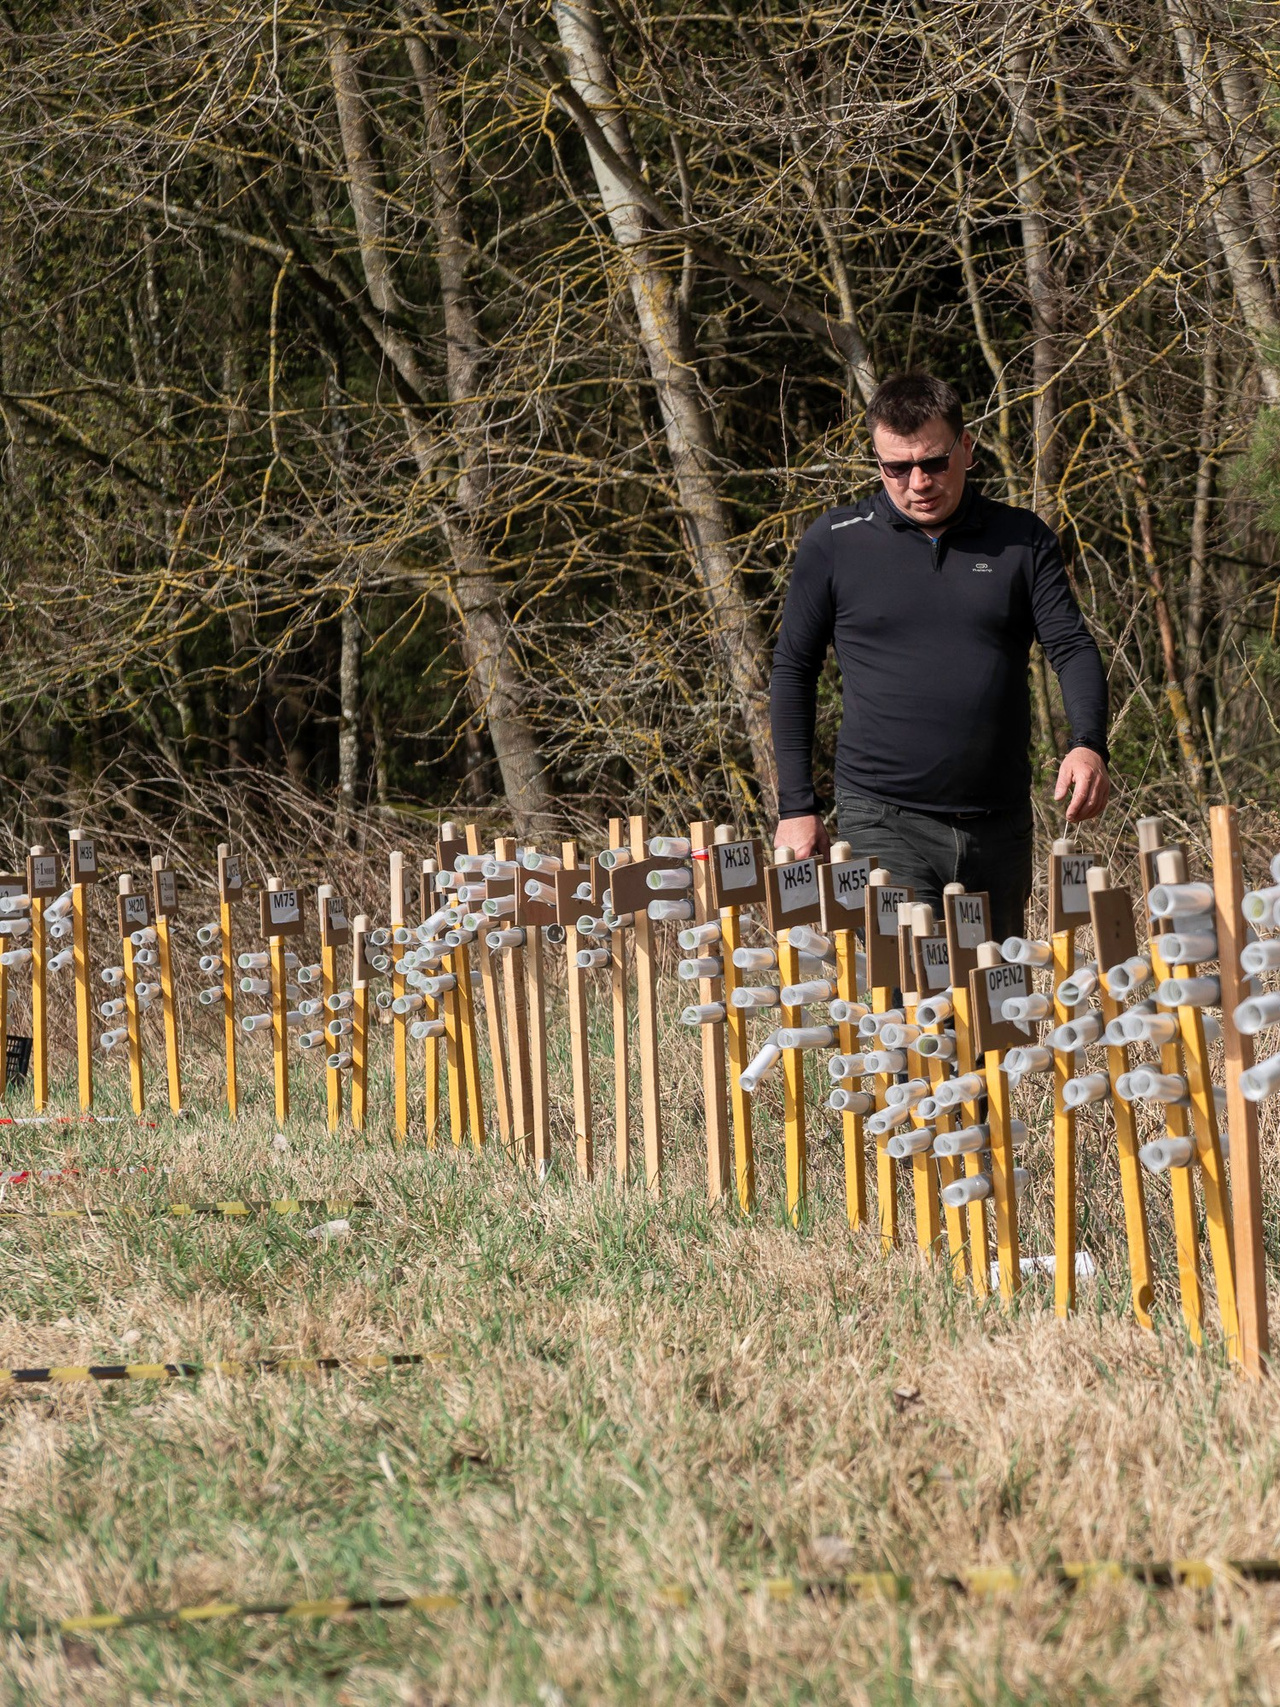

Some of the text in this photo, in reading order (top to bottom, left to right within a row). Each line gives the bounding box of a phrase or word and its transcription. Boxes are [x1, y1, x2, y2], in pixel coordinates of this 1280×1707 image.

[724, 846, 751, 868] Ж18
[783, 863, 812, 890] Ж45
[838, 868, 868, 893] Ж55
[128, 898, 144, 913] Ж20
[989, 964, 1024, 991] OPEN2
